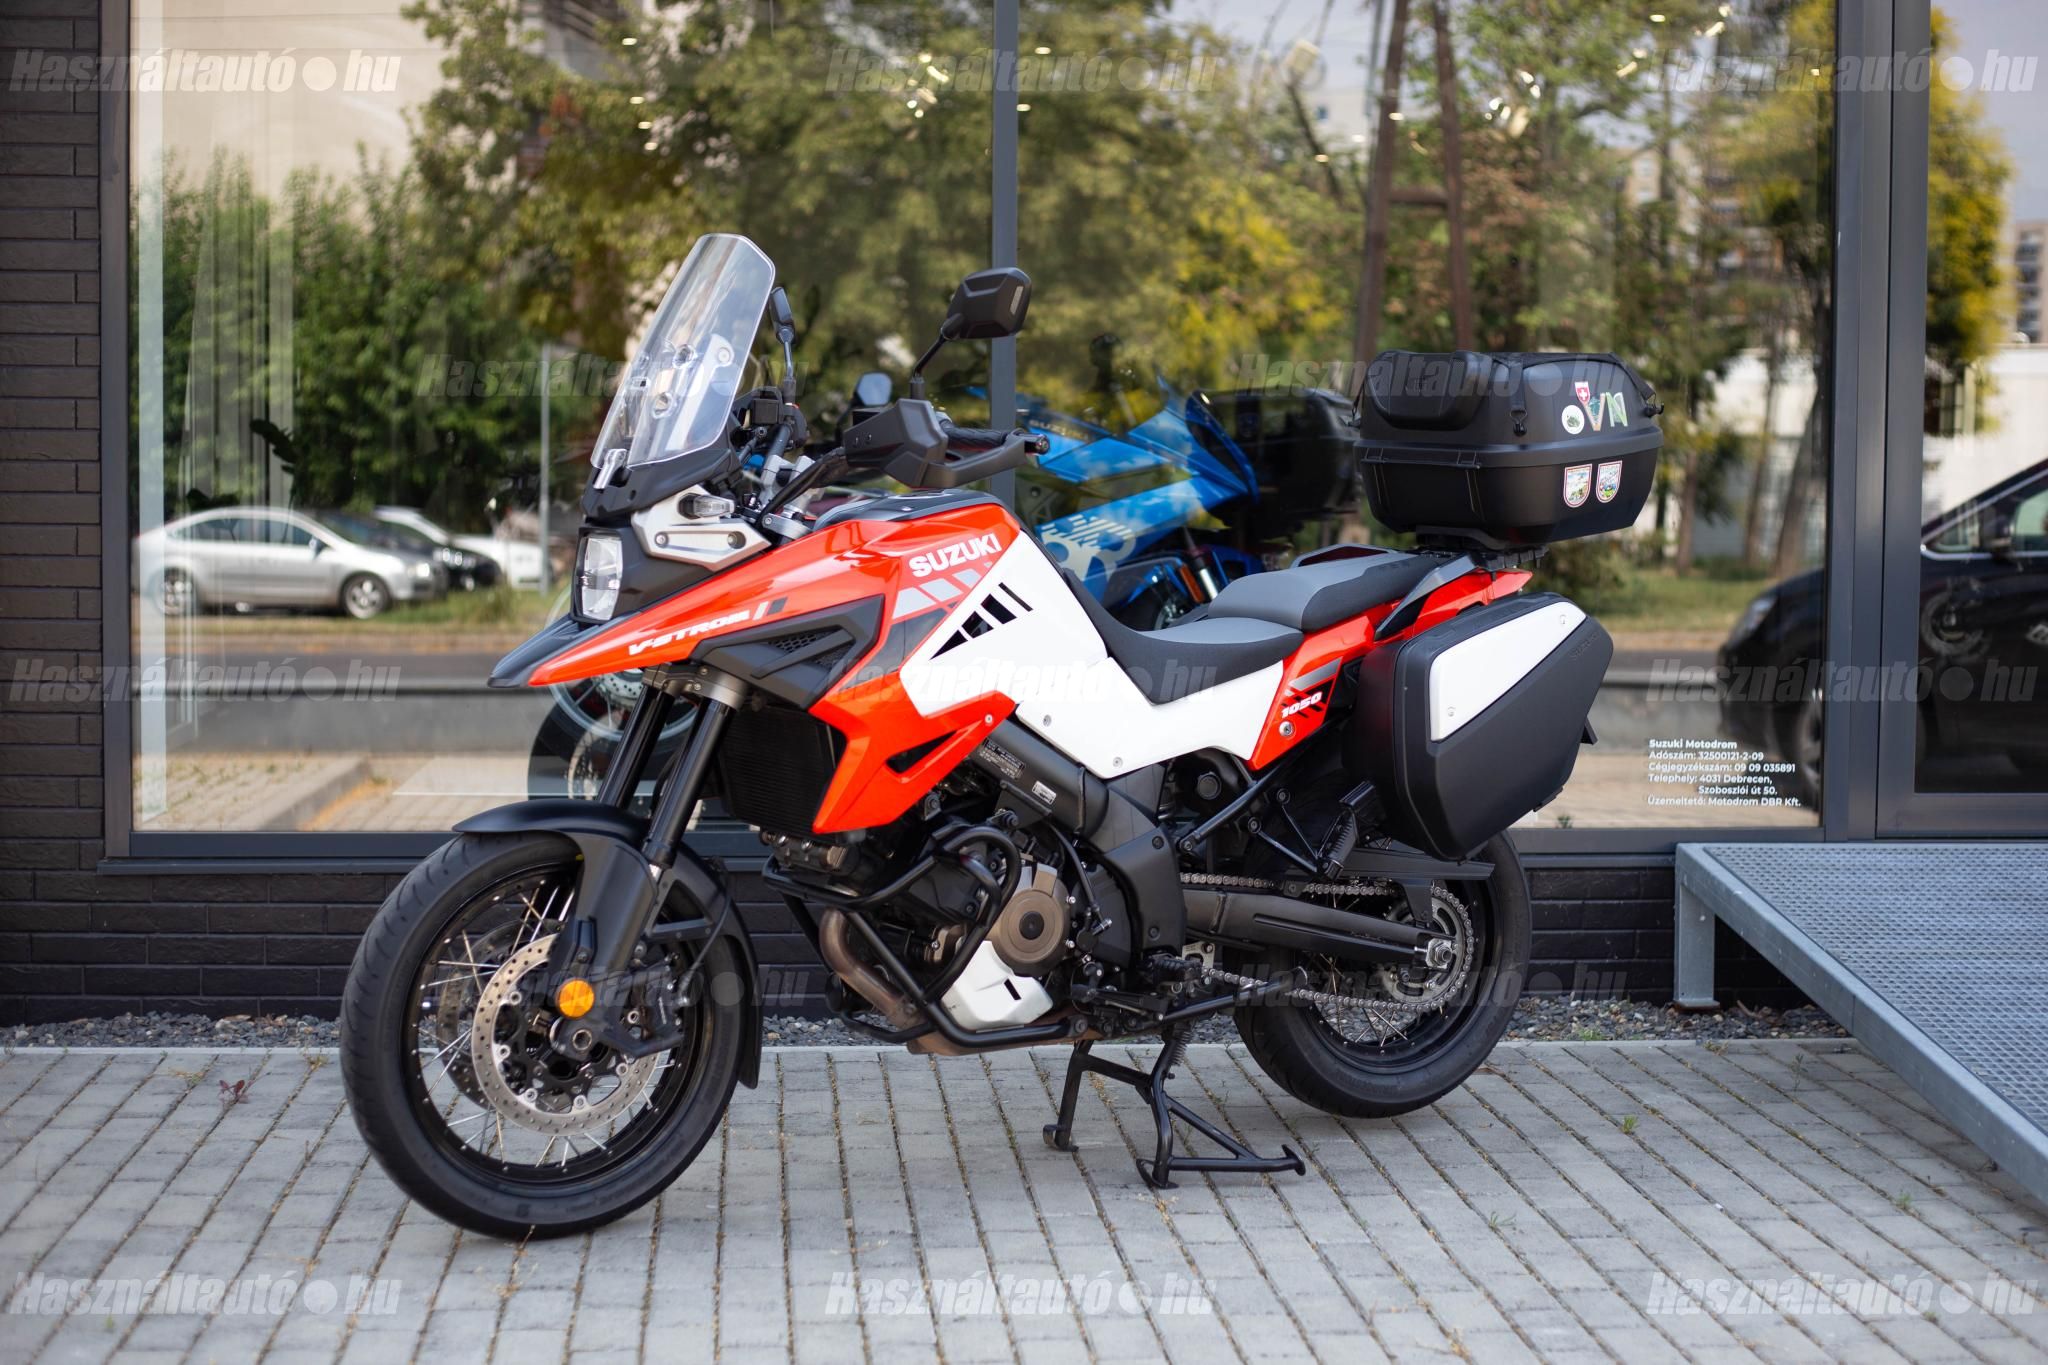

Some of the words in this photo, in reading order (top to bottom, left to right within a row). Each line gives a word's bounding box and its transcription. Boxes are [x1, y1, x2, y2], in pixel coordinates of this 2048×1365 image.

[908, 533, 1002, 577] SUZUKI
[629, 610, 750, 656] V-STROM
[1281, 691, 1322, 719] 1050
[1649, 738, 1683, 749] Suzuki
[1685, 739, 1737, 749] Motodrom
[1734, 763, 1747, 772] 09
[1748, 763, 1761, 772] 09
[1762, 763, 1796, 773] 035891
[1648, 773, 1698, 785] Telephely:
[1699, 774, 1721, 783] 4031
[1723, 774, 1773, 785] Debrecen,
[1698, 784, 1749, 795] Szoboszlói
[1750, 785, 1761, 795] út
[1763, 786, 1778, 795] 50.
[1707, 797, 1759, 807] Motodrom
[1760, 797, 1783, 806] DBR
[1784, 797, 1802, 807] Kft.
